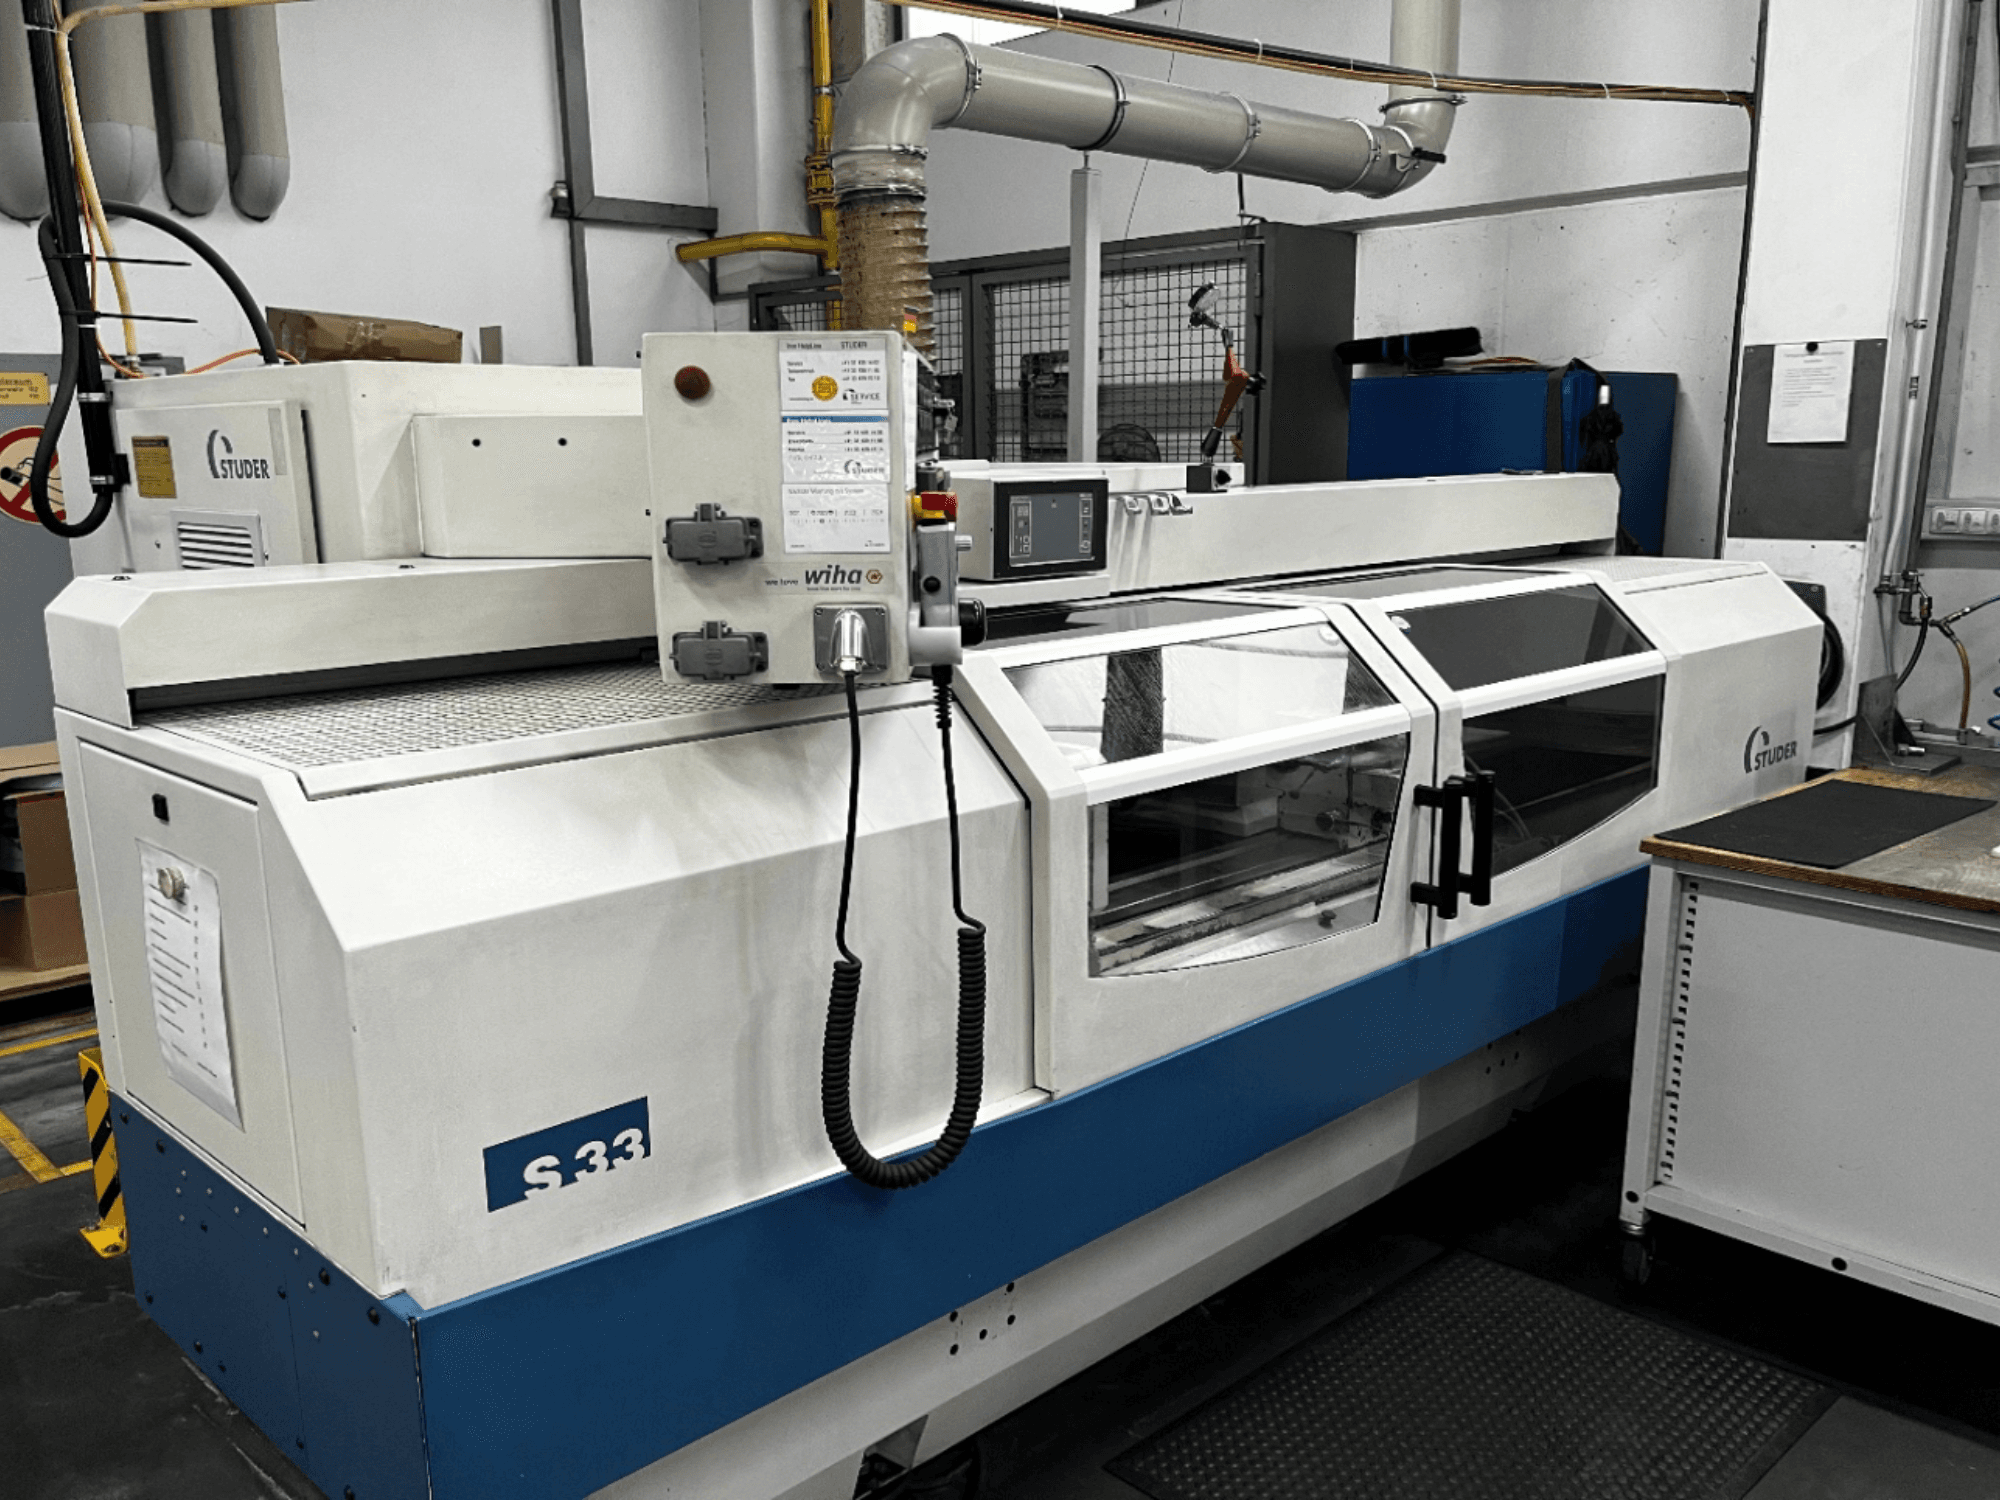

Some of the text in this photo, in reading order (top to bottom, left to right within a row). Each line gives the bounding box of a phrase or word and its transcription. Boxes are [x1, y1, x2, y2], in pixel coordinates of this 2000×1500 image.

[220, 459, 270, 479] STUDER
[805, 564, 862, 585] wiha
[1754, 740, 1797, 771] STUDER
[523, 1127, 646, 1199] S 33
